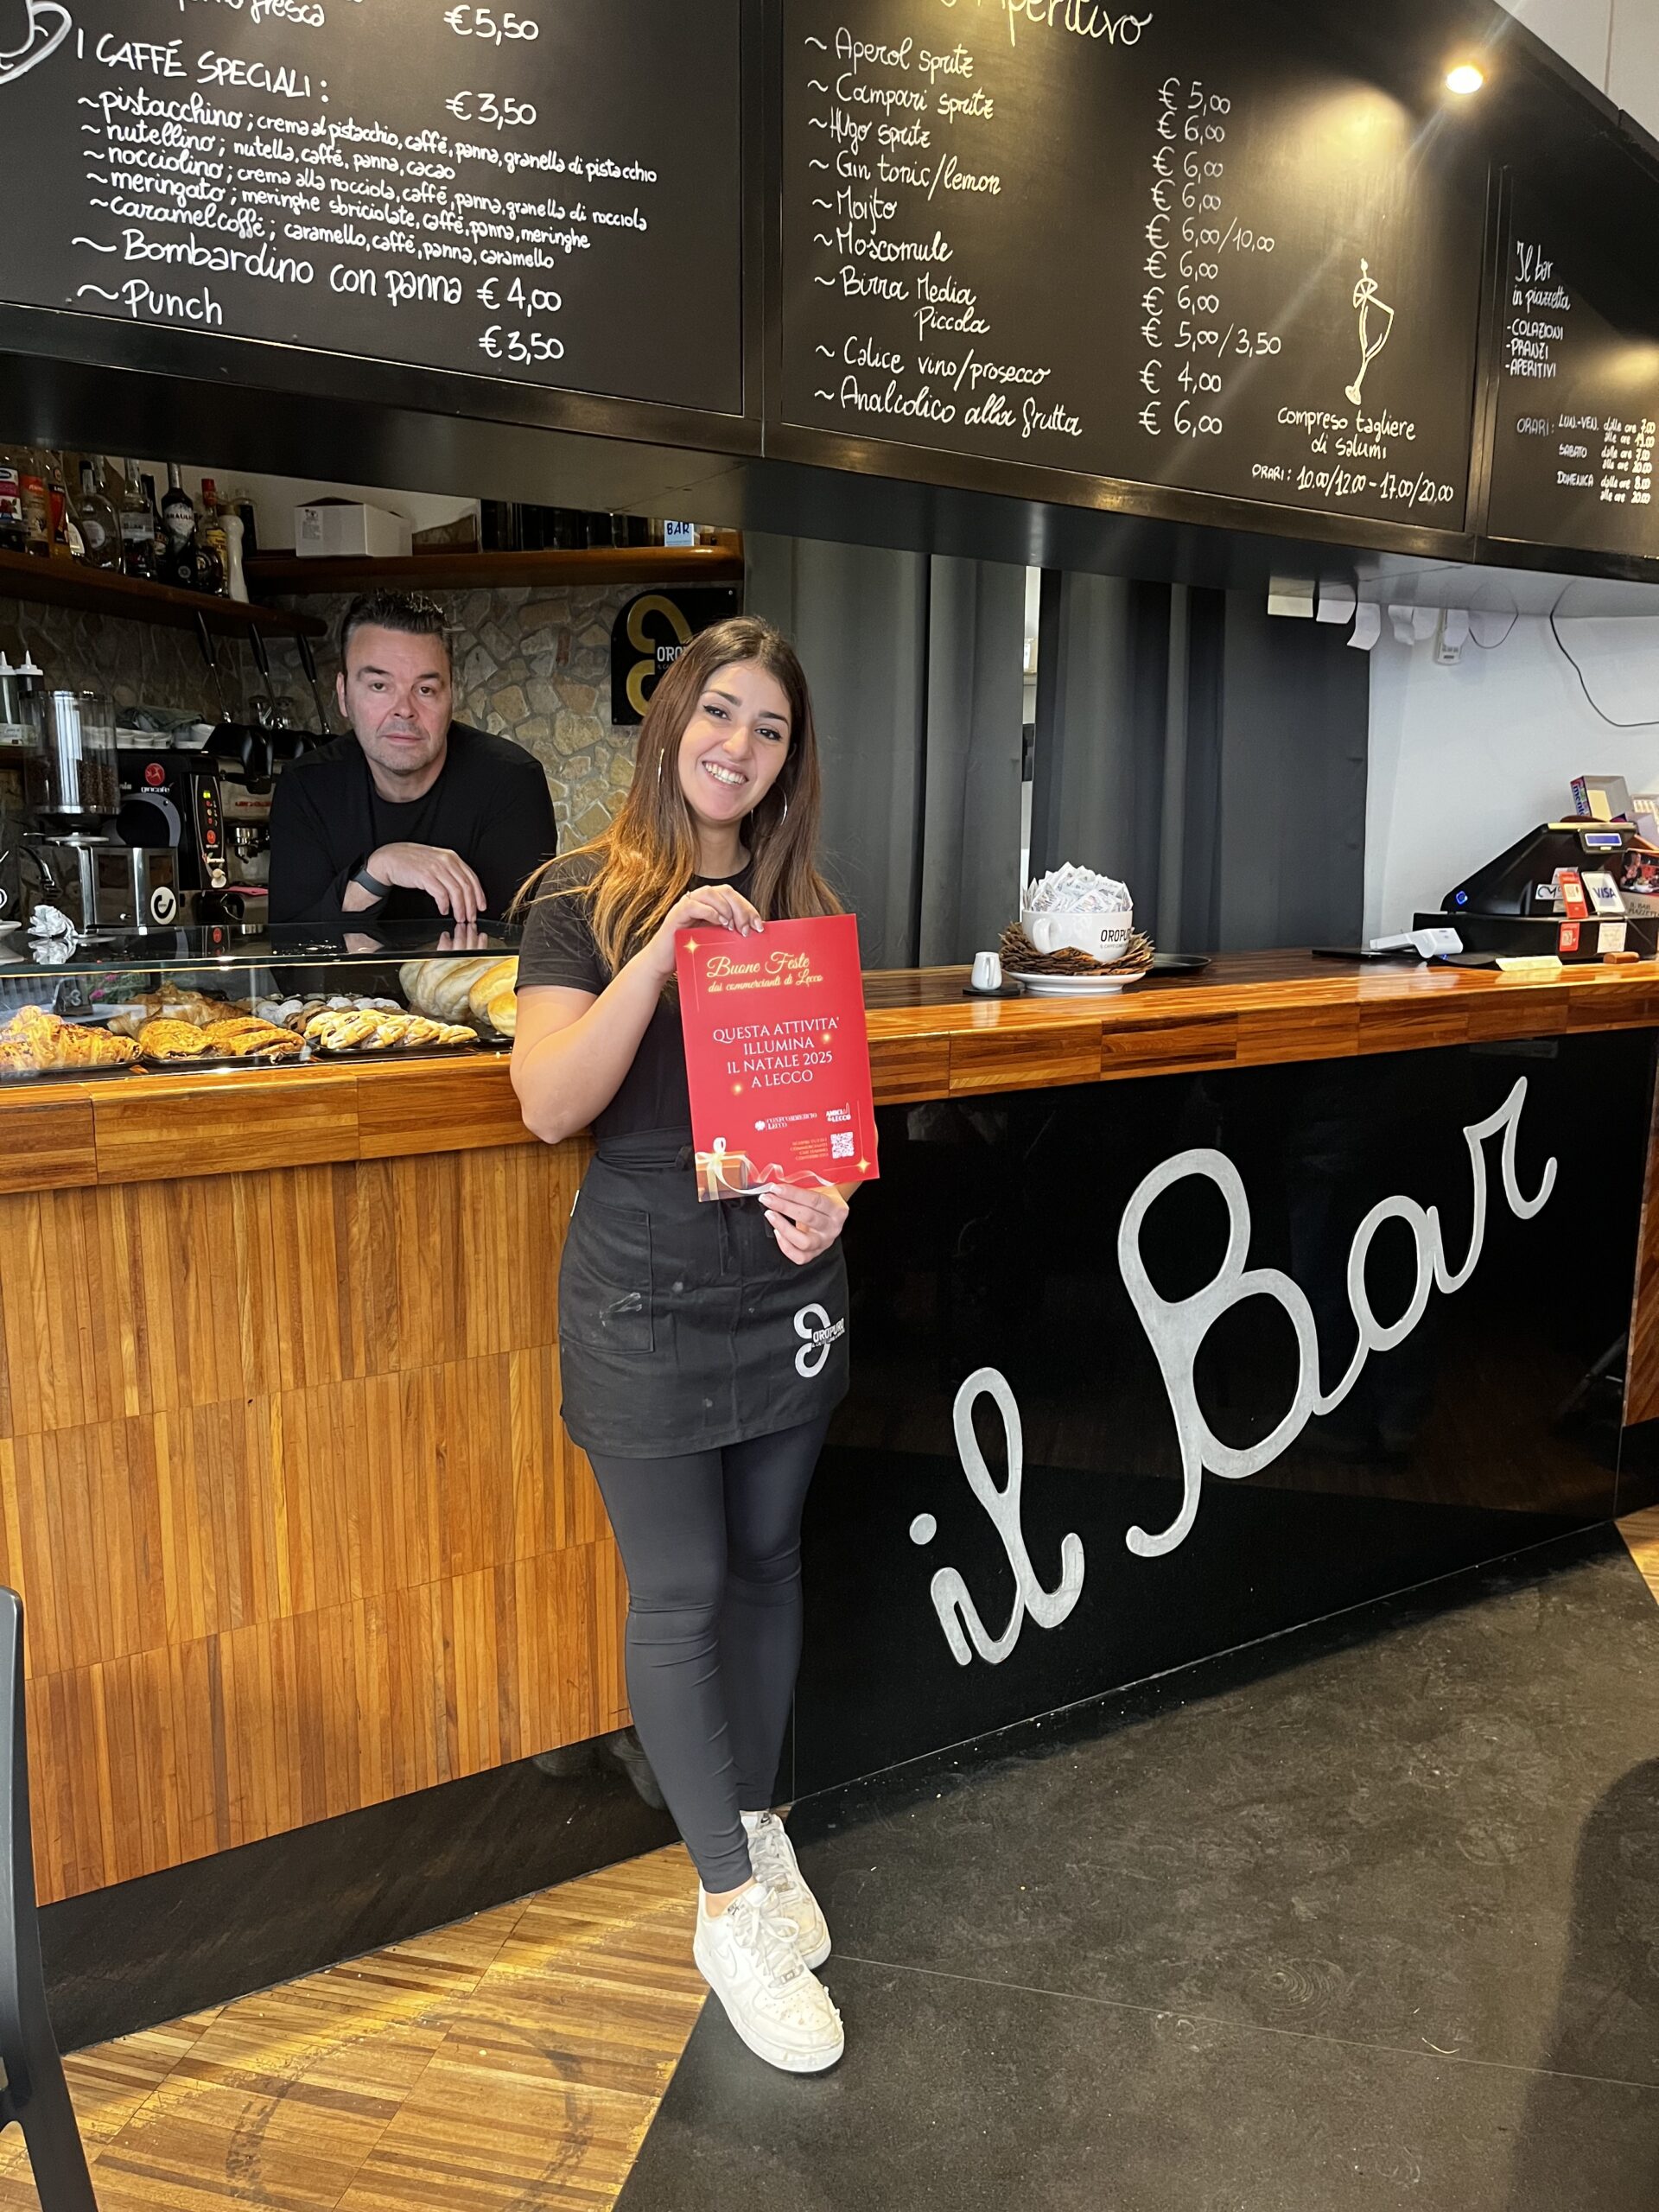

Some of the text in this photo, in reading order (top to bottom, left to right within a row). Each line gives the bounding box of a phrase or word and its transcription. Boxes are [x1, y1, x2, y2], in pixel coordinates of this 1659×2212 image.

[96, 34, 187, 77] CAFFÉ
[836, 27, 912, 74] Aperol
[836, 73, 927, 117] Campari
[257, 117, 308, 136] crema
[311, 116, 327, 136] al
[504, 149, 566, 174] granella
[569, 155, 583, 175] di
[586, 159, 657, 182] pistacchio
[836, 150, 870, 180] Gin
[406, 161, 455, 180] cacao
[237, 168, 291, 184] crema
[296, 168, 325, 190] alla
[505, 199, 566, 220] granella
[569, 202, 587, 221] di
[592, 207, 647, 231] nocciola
[242, 188, 321, 215] meringhe
[521, 226, 590, 253] meringhe
[123, 228, 314, 284] Bombardino
[329, 264, 376, 296] con
[385, 269, 462, 306] panna
[480, 247, 554, 269] caramello
[1535, 245, 1554, 282] bar
[123, 279, 222, 325] Punch
[840, 265, 976, 307] Birra Media
[1512, 285, 1571, 314] in piazzetta
[913, 306, 990, 341] Piccola
[843, 335, 905, 374] Calice
[840, 375, 955, 423] Analcolico
[964, 393, 1017, 428] alla
[1356, 409, 1416, 442] tagliere
[1312, 432, 1328, 454] di
[666, 522, 690, 535] BAR
[1593, 887, 1617, 899] VISA
[707, 951, 810, 977] Buone Feste
[709, 969, 823, 993] dai commercianti di Lecco
[713, 1017, 839, 1044] QUESTA ATTIVITA'
[743, 1036, 815, 1055] ILLUMINA
[728, 1051, 833, 1074] IL NATALE 2025
[752, 1070, 813, 1088] A LECCO
[910, 1077, 1556, 1665] il Bar
